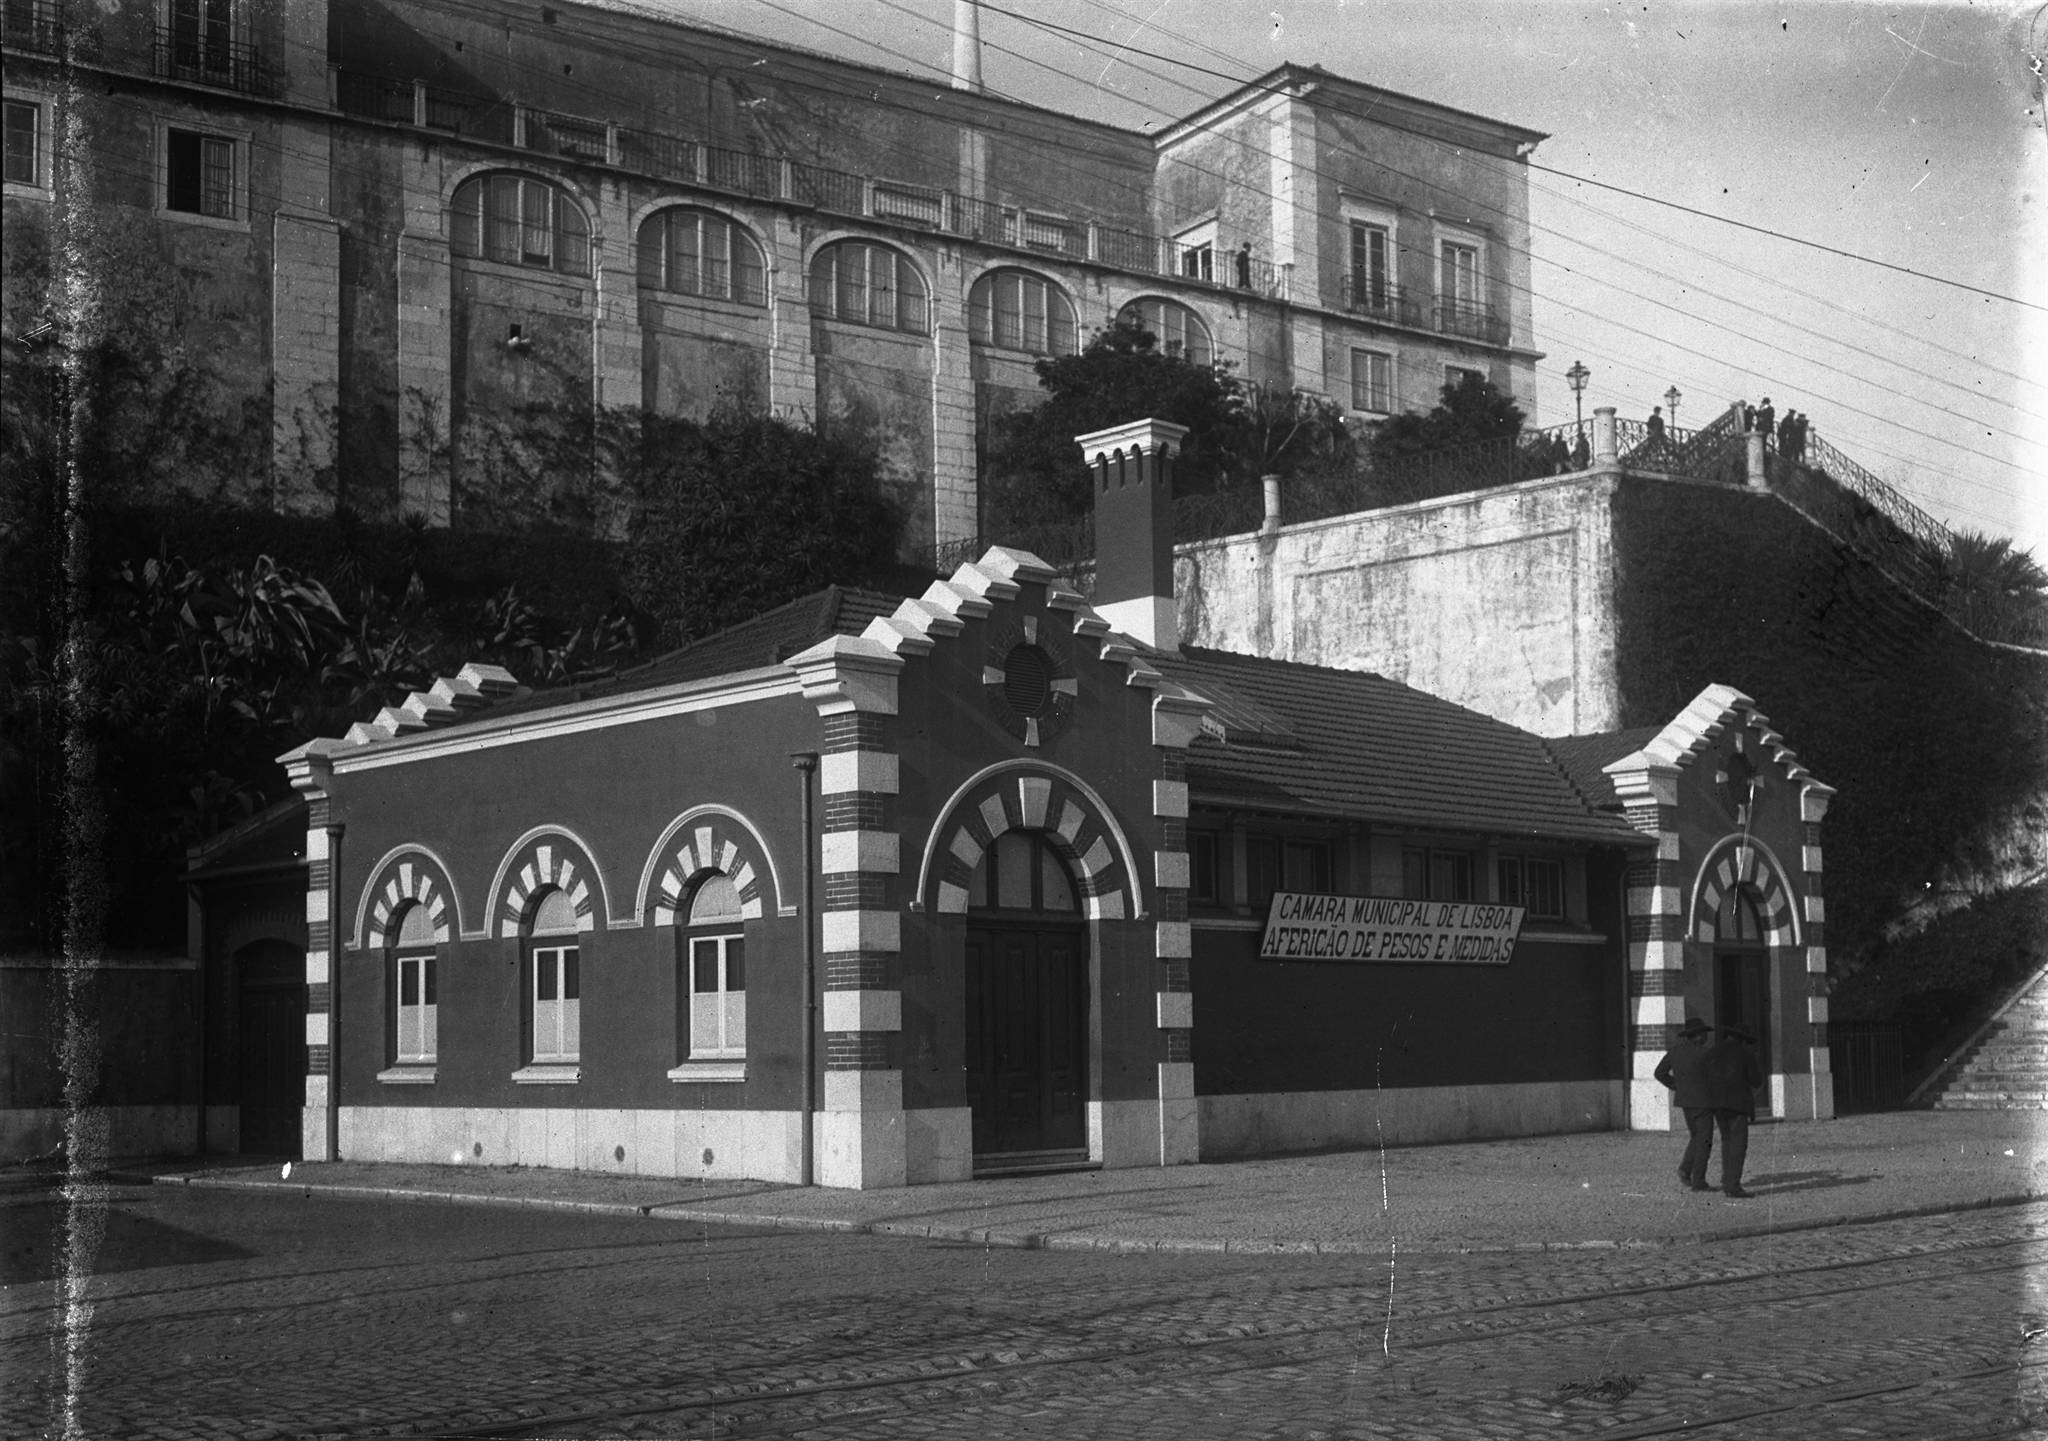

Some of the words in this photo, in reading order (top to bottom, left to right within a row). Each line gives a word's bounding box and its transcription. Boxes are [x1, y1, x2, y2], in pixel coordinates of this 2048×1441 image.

[1280, 894, 1347, 923] CAMARA
[1352, 898, 1430, 927] MUNICIPAL
[1437, 904, 1460, 928] DE
[1460, 905, 1513, 930] LISBOA
[1350, 930, 1377, 957] DE
[1378, 931, 1433, 959] PESOS
[1433, 934, 1449, 960] E
[1448, 934, 1514, 961] MEDIDAS
